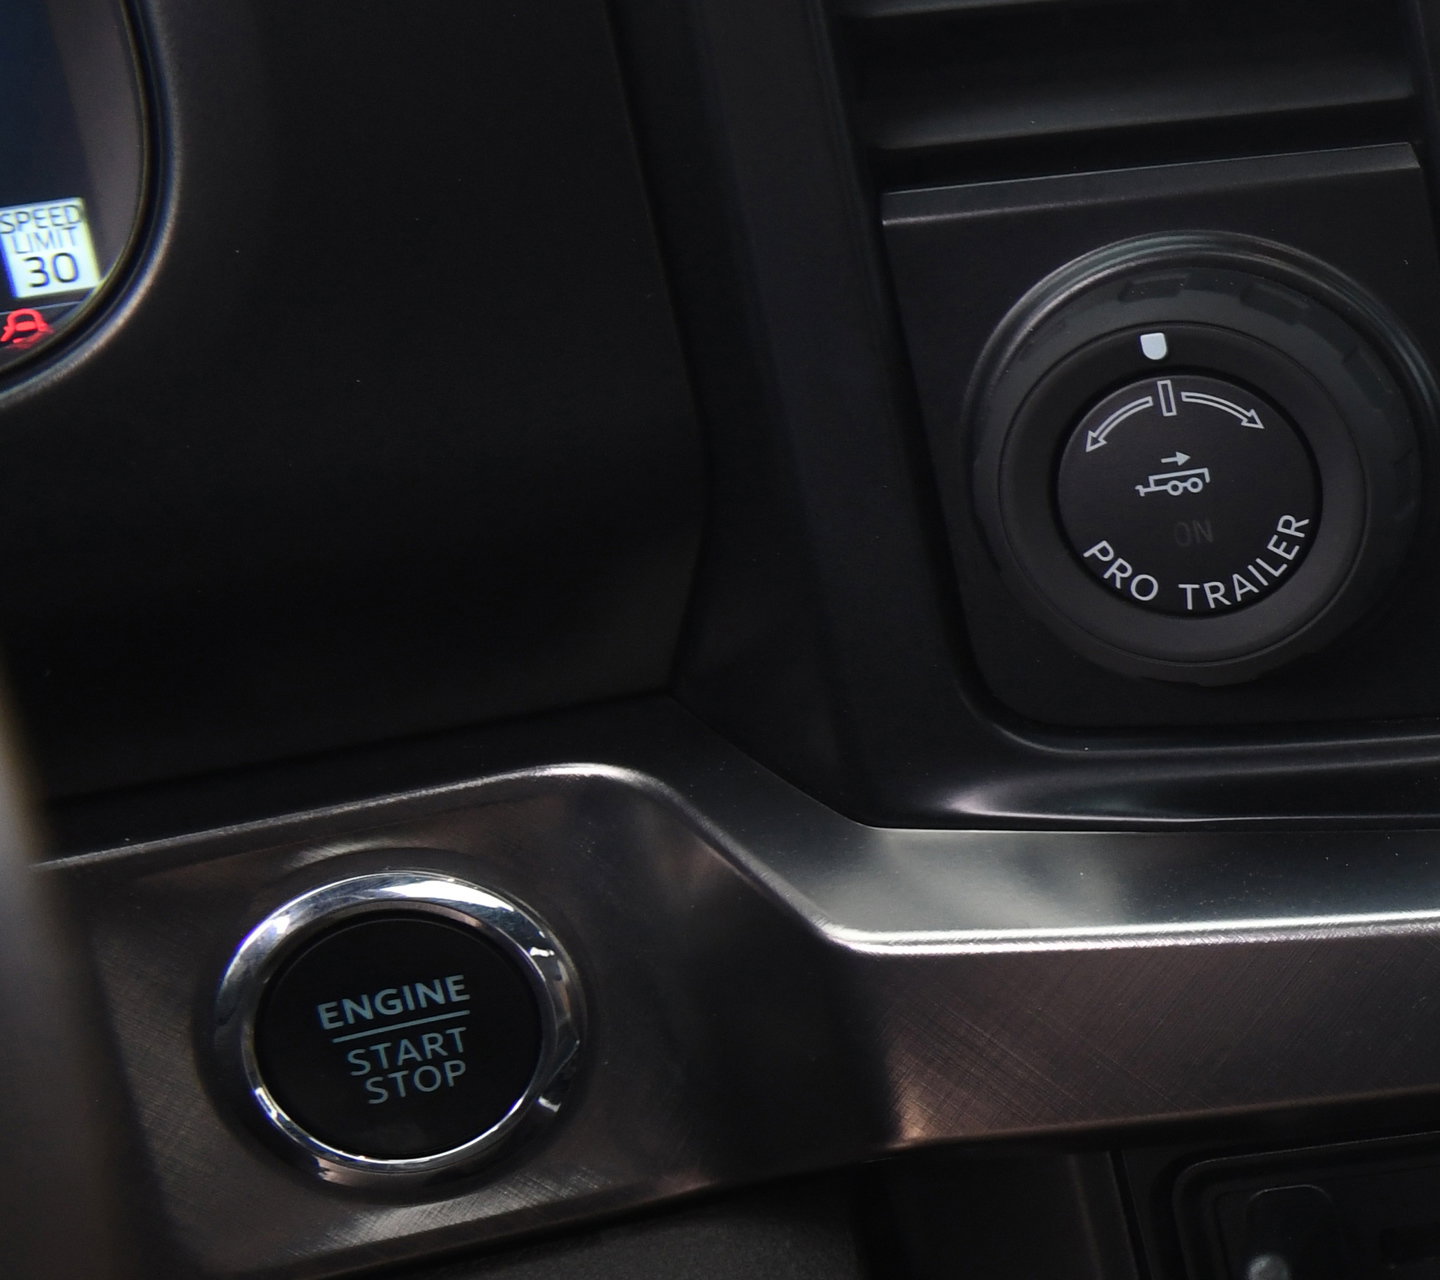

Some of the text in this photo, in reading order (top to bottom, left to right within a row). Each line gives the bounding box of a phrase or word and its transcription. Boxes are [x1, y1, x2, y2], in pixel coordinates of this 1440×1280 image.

[0, 205, 82, 235] SPEED
[11, 226, 78, 255] LIMIT
[23, 251, 80, 288] 30
[1084, 515, 1309, 609] PRO TRAILER
[318, 974, 471, 1031] ENGINE
[346, 1026, 467, 1077] START
[364, 1059, 467, 1105] STOP
